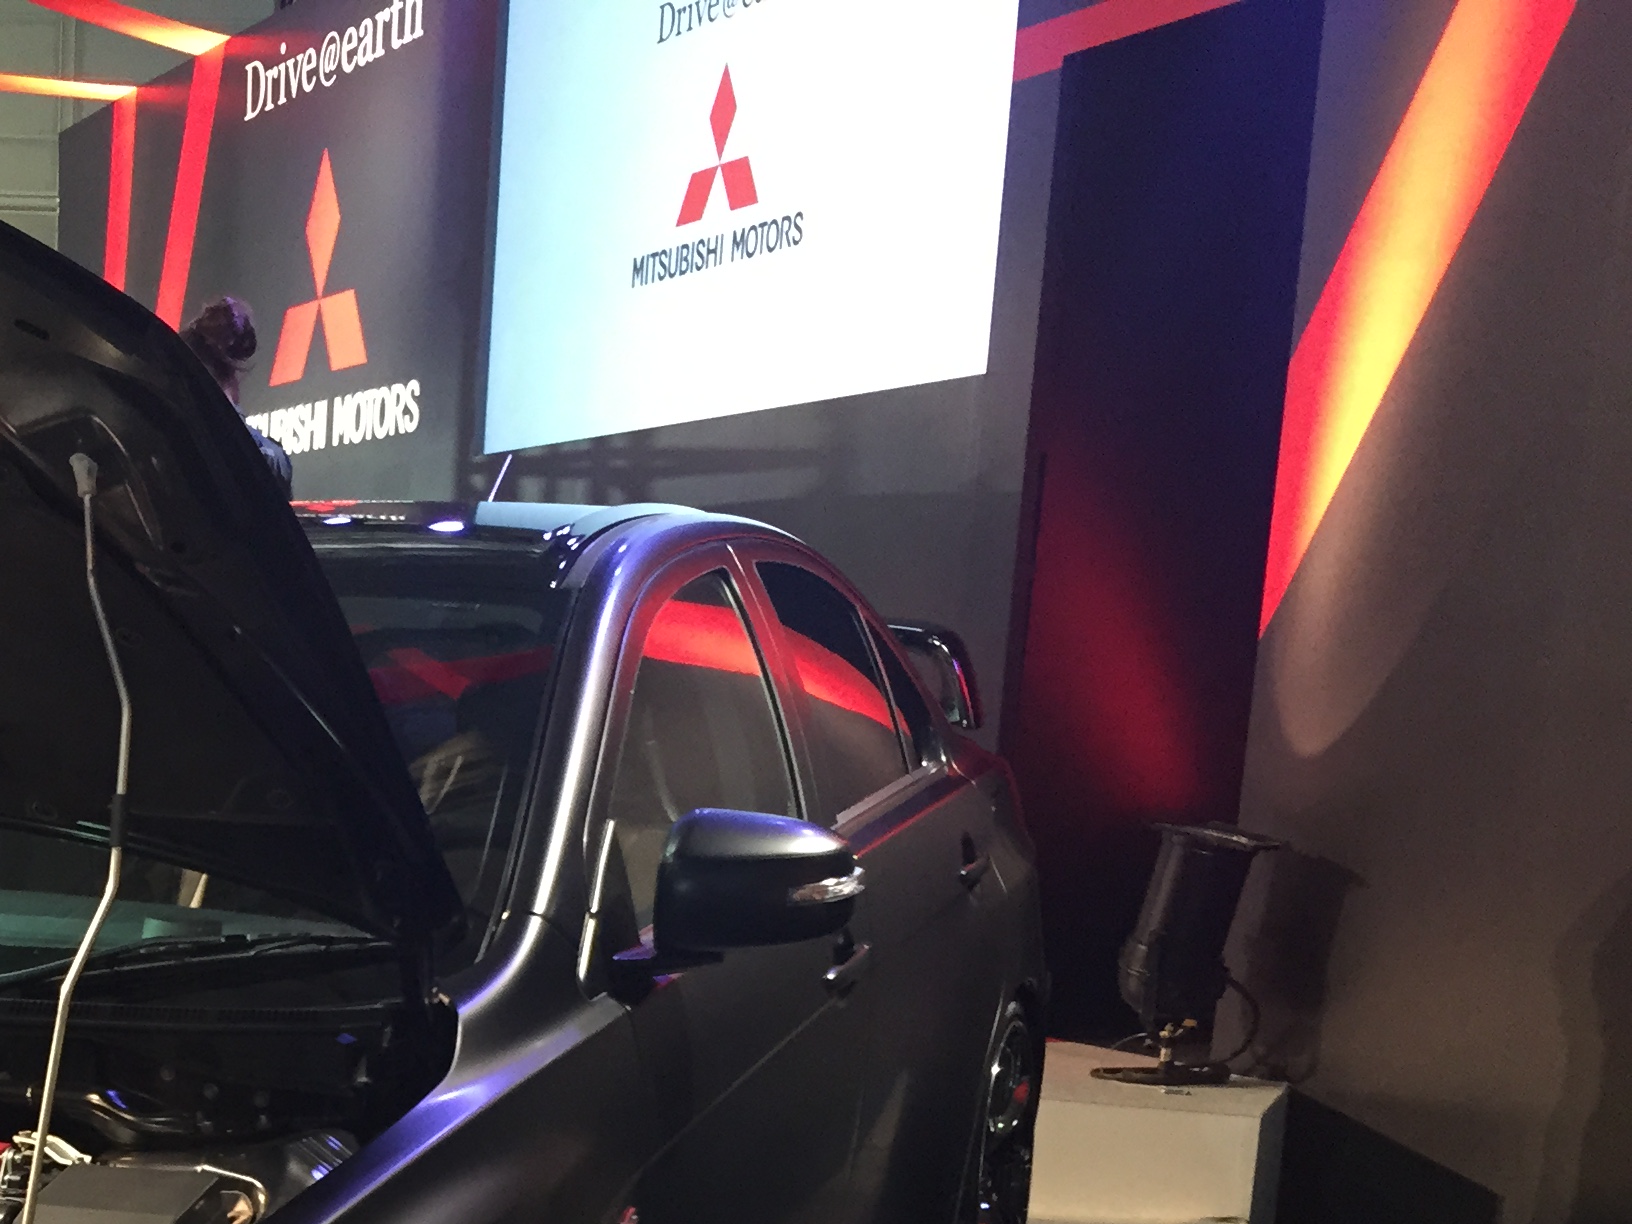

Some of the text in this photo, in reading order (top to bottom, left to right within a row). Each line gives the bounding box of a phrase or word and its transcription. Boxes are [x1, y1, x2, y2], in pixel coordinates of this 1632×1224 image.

[243, 0, 424, 121] Drive@earth
[631, 211, 804, 288] MITSUBISHI MOTORS
[332, 379, 421, 447] MOTORS
